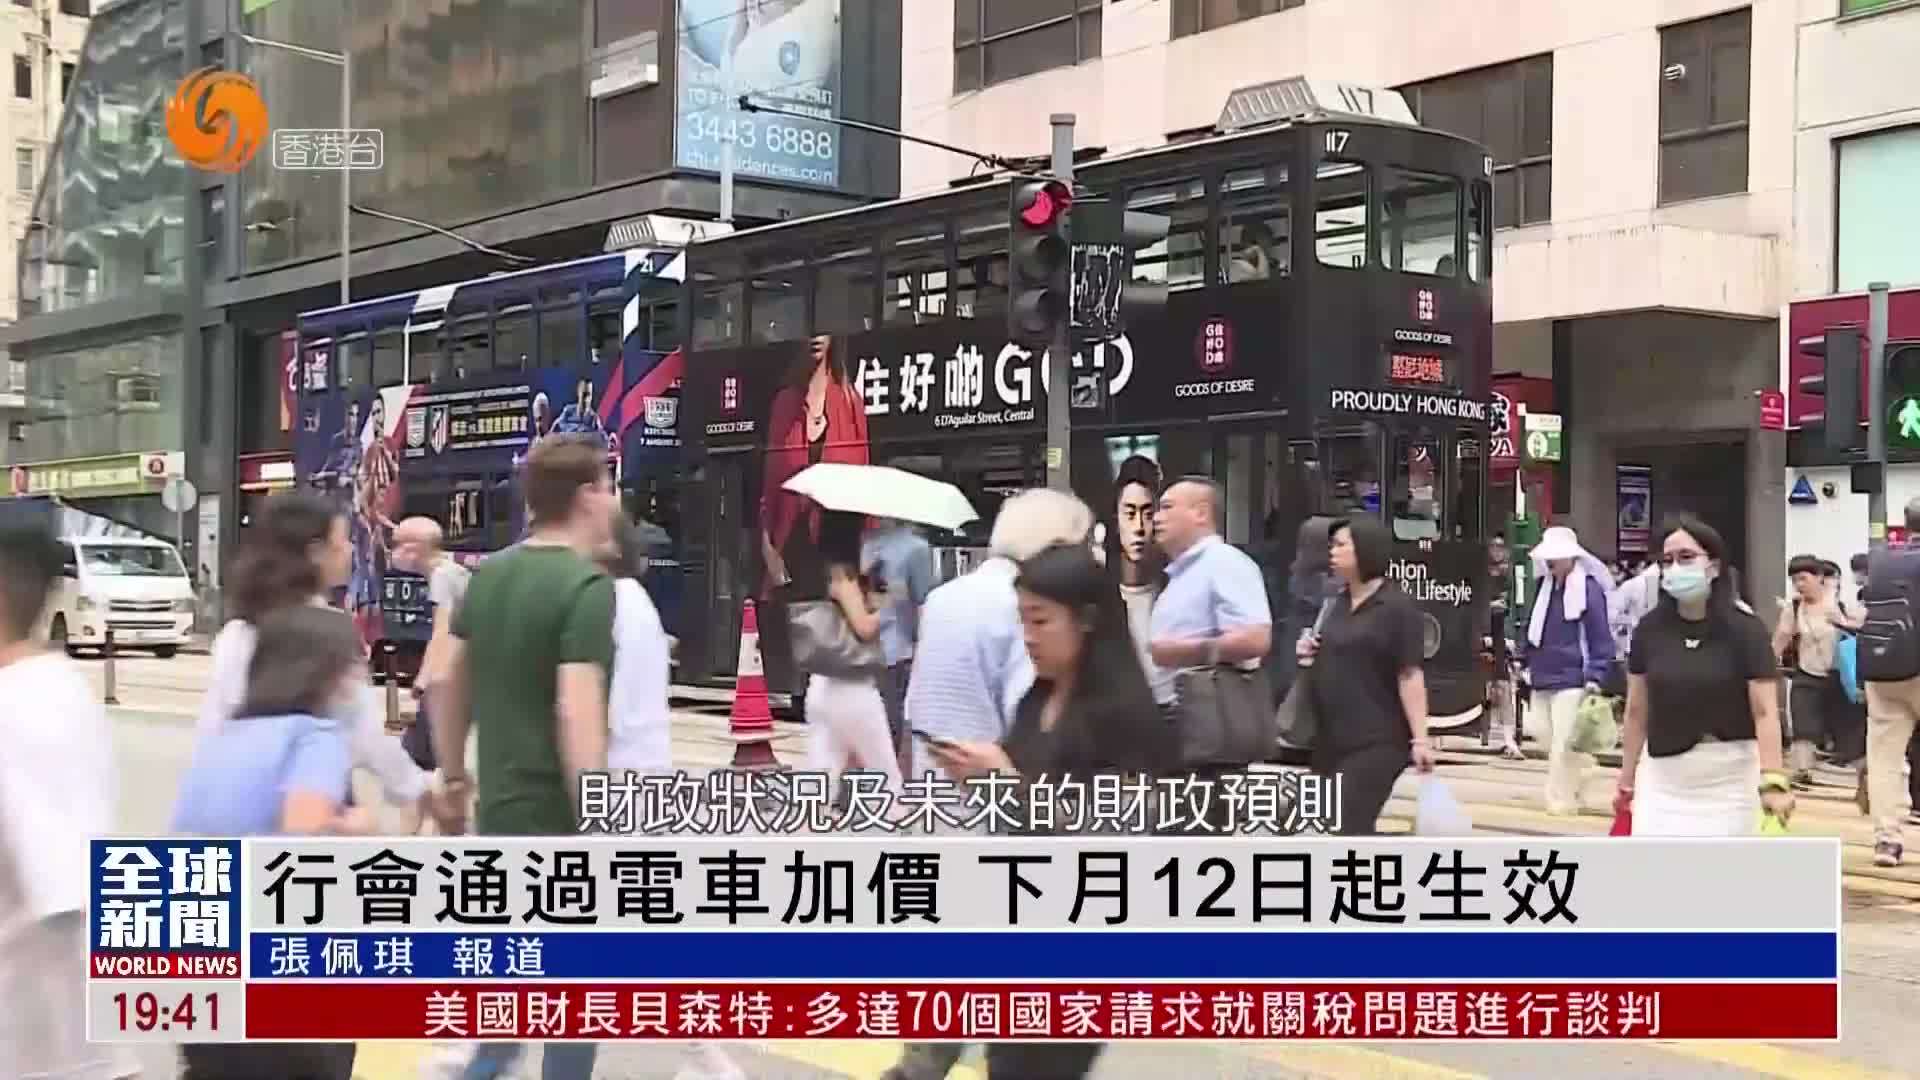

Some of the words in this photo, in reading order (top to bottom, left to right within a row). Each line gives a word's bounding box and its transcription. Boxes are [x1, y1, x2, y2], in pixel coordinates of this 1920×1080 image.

[1337, 84, 1374, 114] 117
[765, 124, 833, 159] 6888
[1326, 131, 1350, 153] 117
[681, 222, 706, 241] 21
[640, 257, 653, 273] 21
[994, 332, 1133, 405] GD
[1175, 382, 1210, 397] GOODS
[1211, 381, 1225, 394] OF
[1225, 378, 1255, 393] DESIRE
[977, 410, 1003, 425] Street,
[1003, 407, 1034, 422] Central
[1331, 389, 1413, 413] PROUDLY
[1416, 395, 1457, 418] HONG
[1458, 399, 1486, 421] KONG
[1384, 558, 1428, 580] hion
[1416, 579, 1473, 607] Lifestyle
